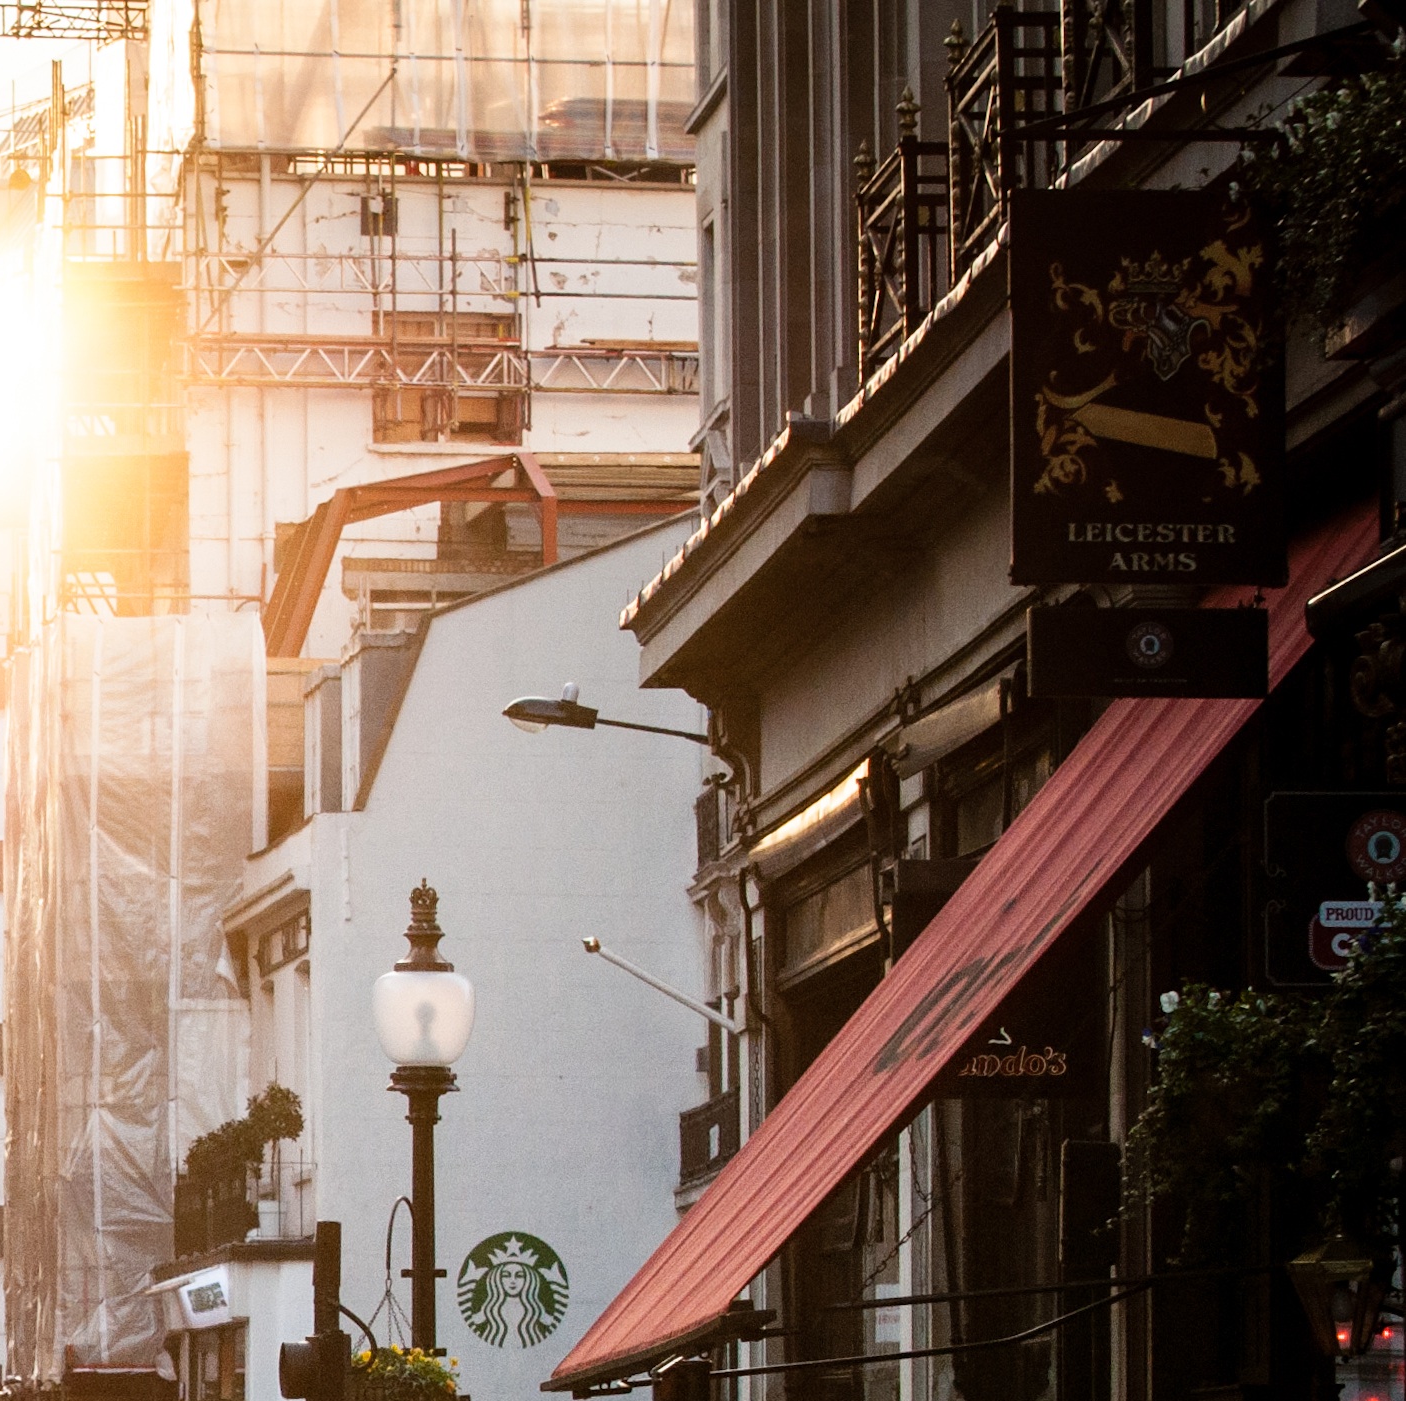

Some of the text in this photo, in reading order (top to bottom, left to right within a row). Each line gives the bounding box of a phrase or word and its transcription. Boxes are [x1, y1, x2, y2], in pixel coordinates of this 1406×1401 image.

[1067, 523, 1236, 543] LEICESTER
[1108, 552, 1198, 571] ARMS
[1326, 907, 1375, 921] PROUD
